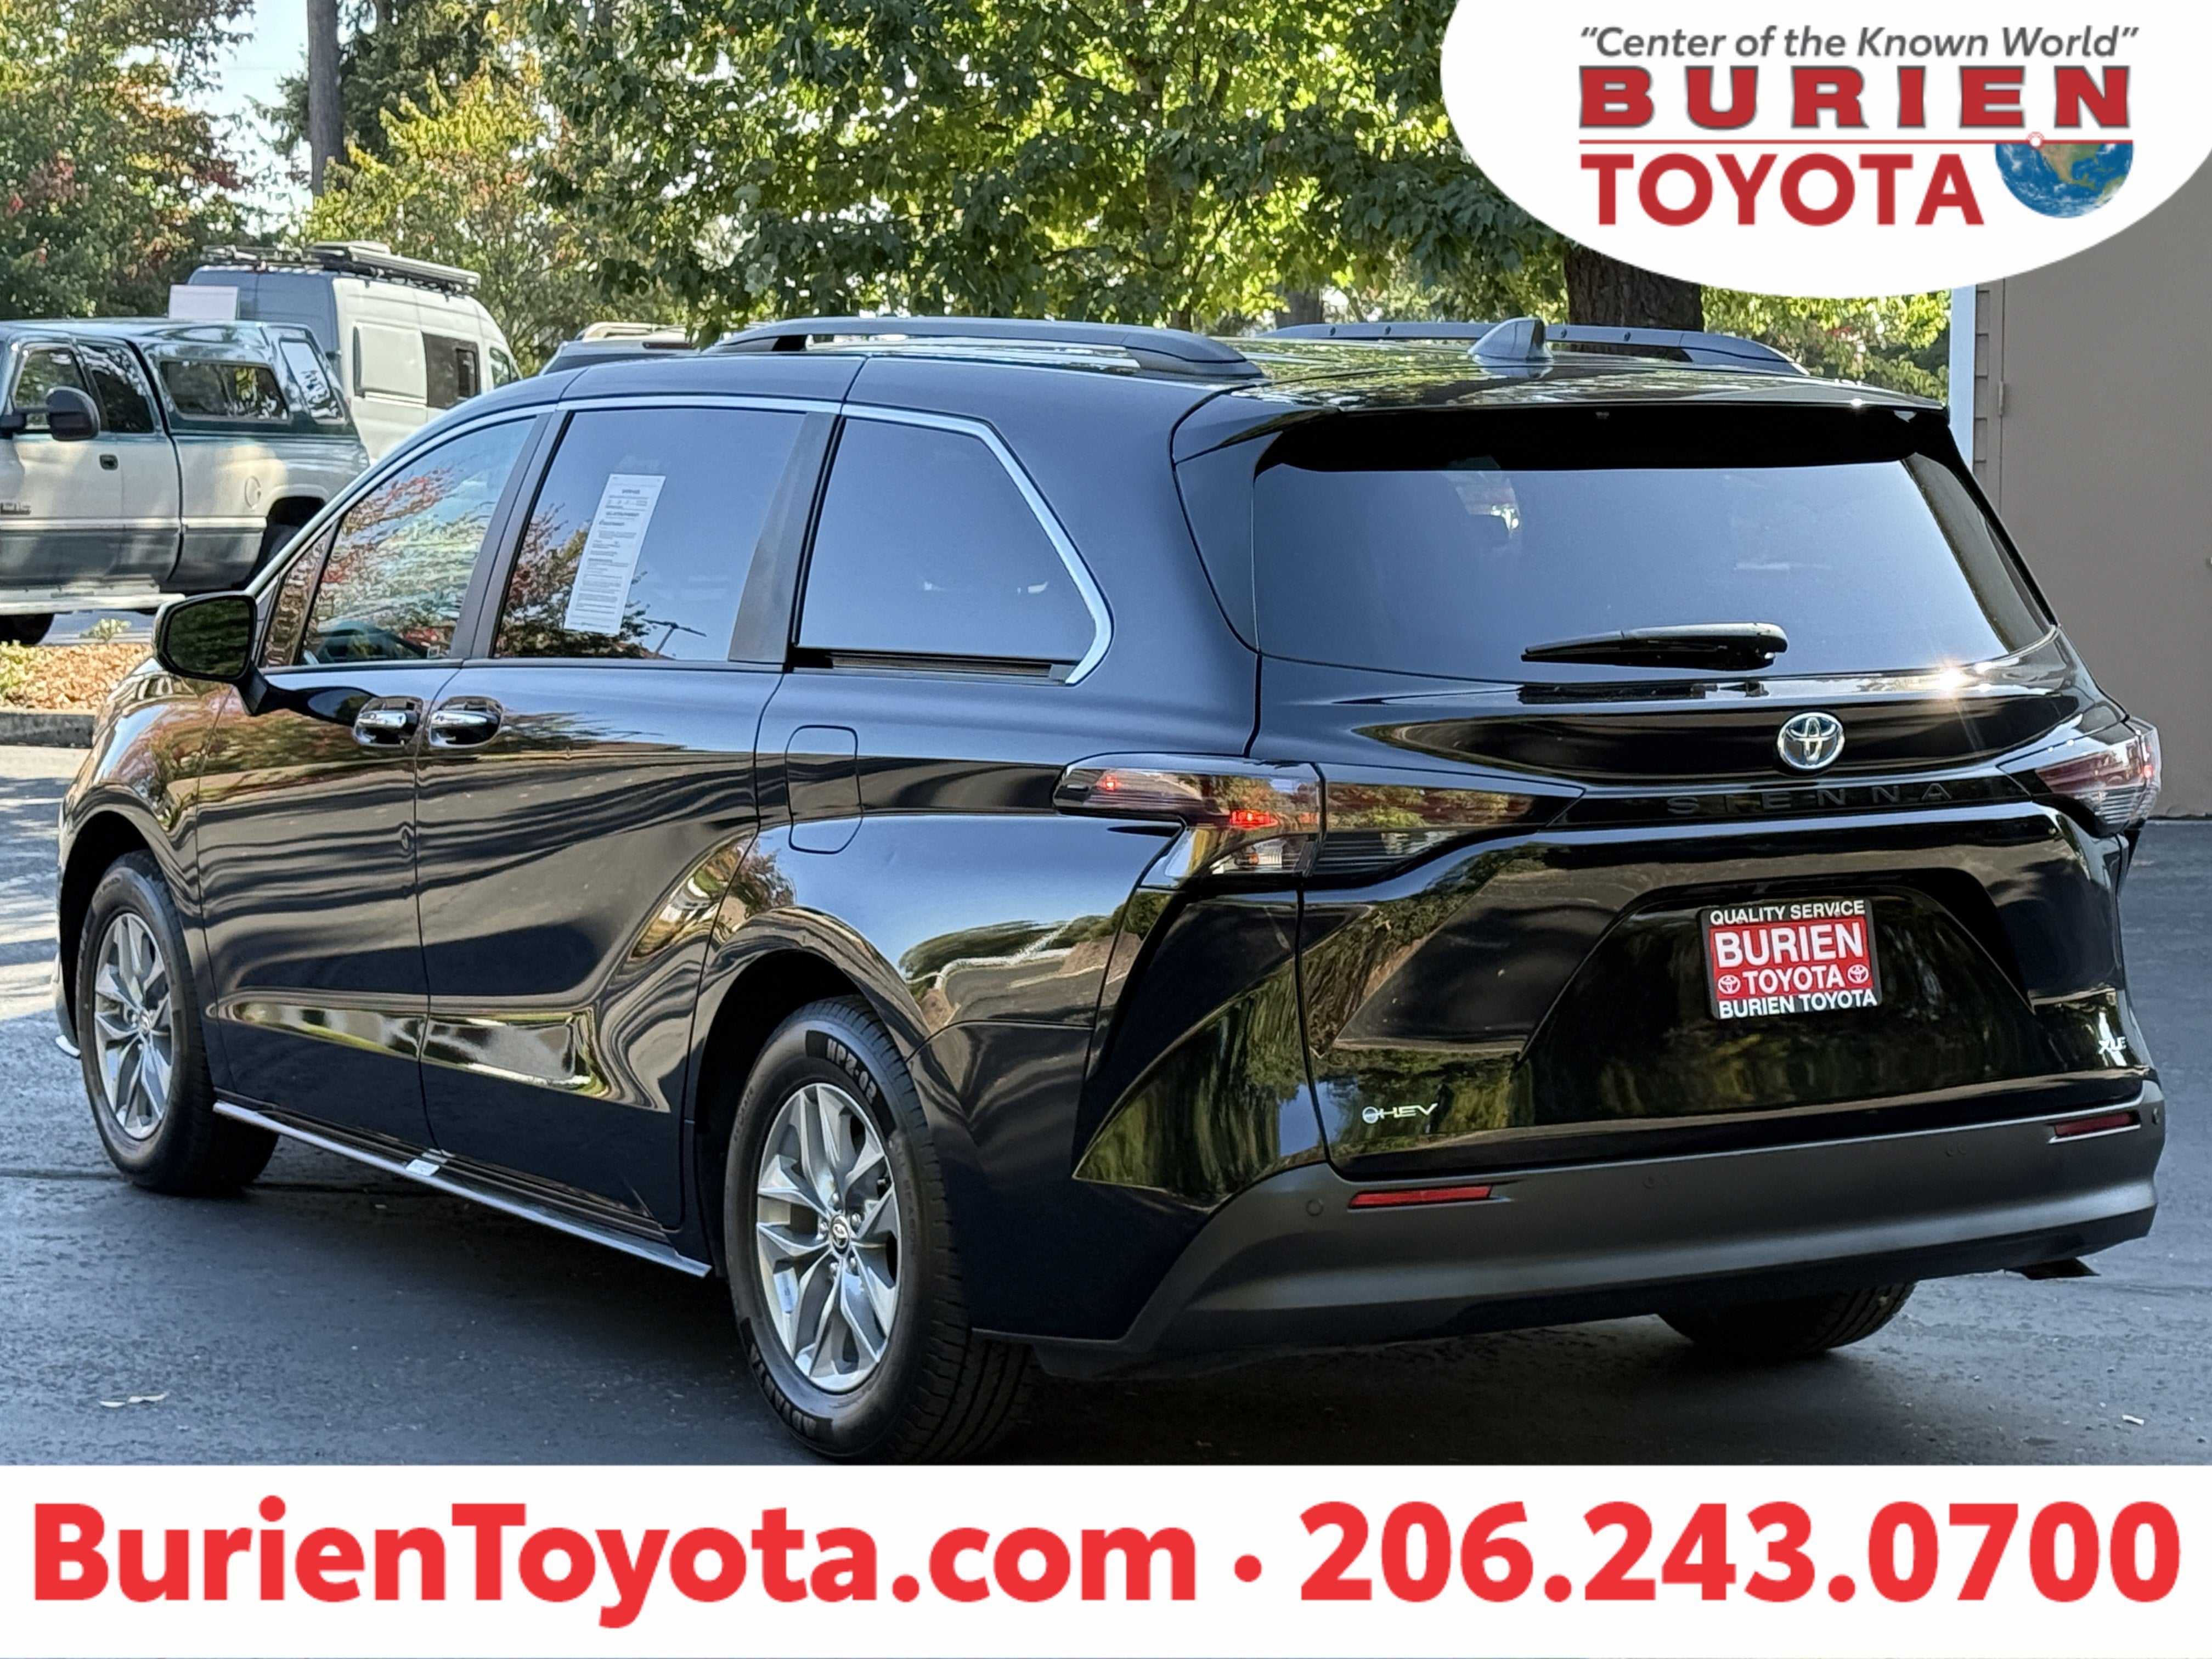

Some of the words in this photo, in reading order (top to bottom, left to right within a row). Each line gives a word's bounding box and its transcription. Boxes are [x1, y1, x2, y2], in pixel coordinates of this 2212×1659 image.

[1666, 782, 1953, 815] SIENNA
[1710, 906, 1785, 925] QUALITY
[1790, 900, 1865, 919] SERVICE
[1715, 922, 1864, 968] BURIEN
[1742, 964, 1846, 995] TOYOTA
[1719, 995, 1795, 1019] BURIEN
[1799, 989, 1877, 1011] TOYOTA
